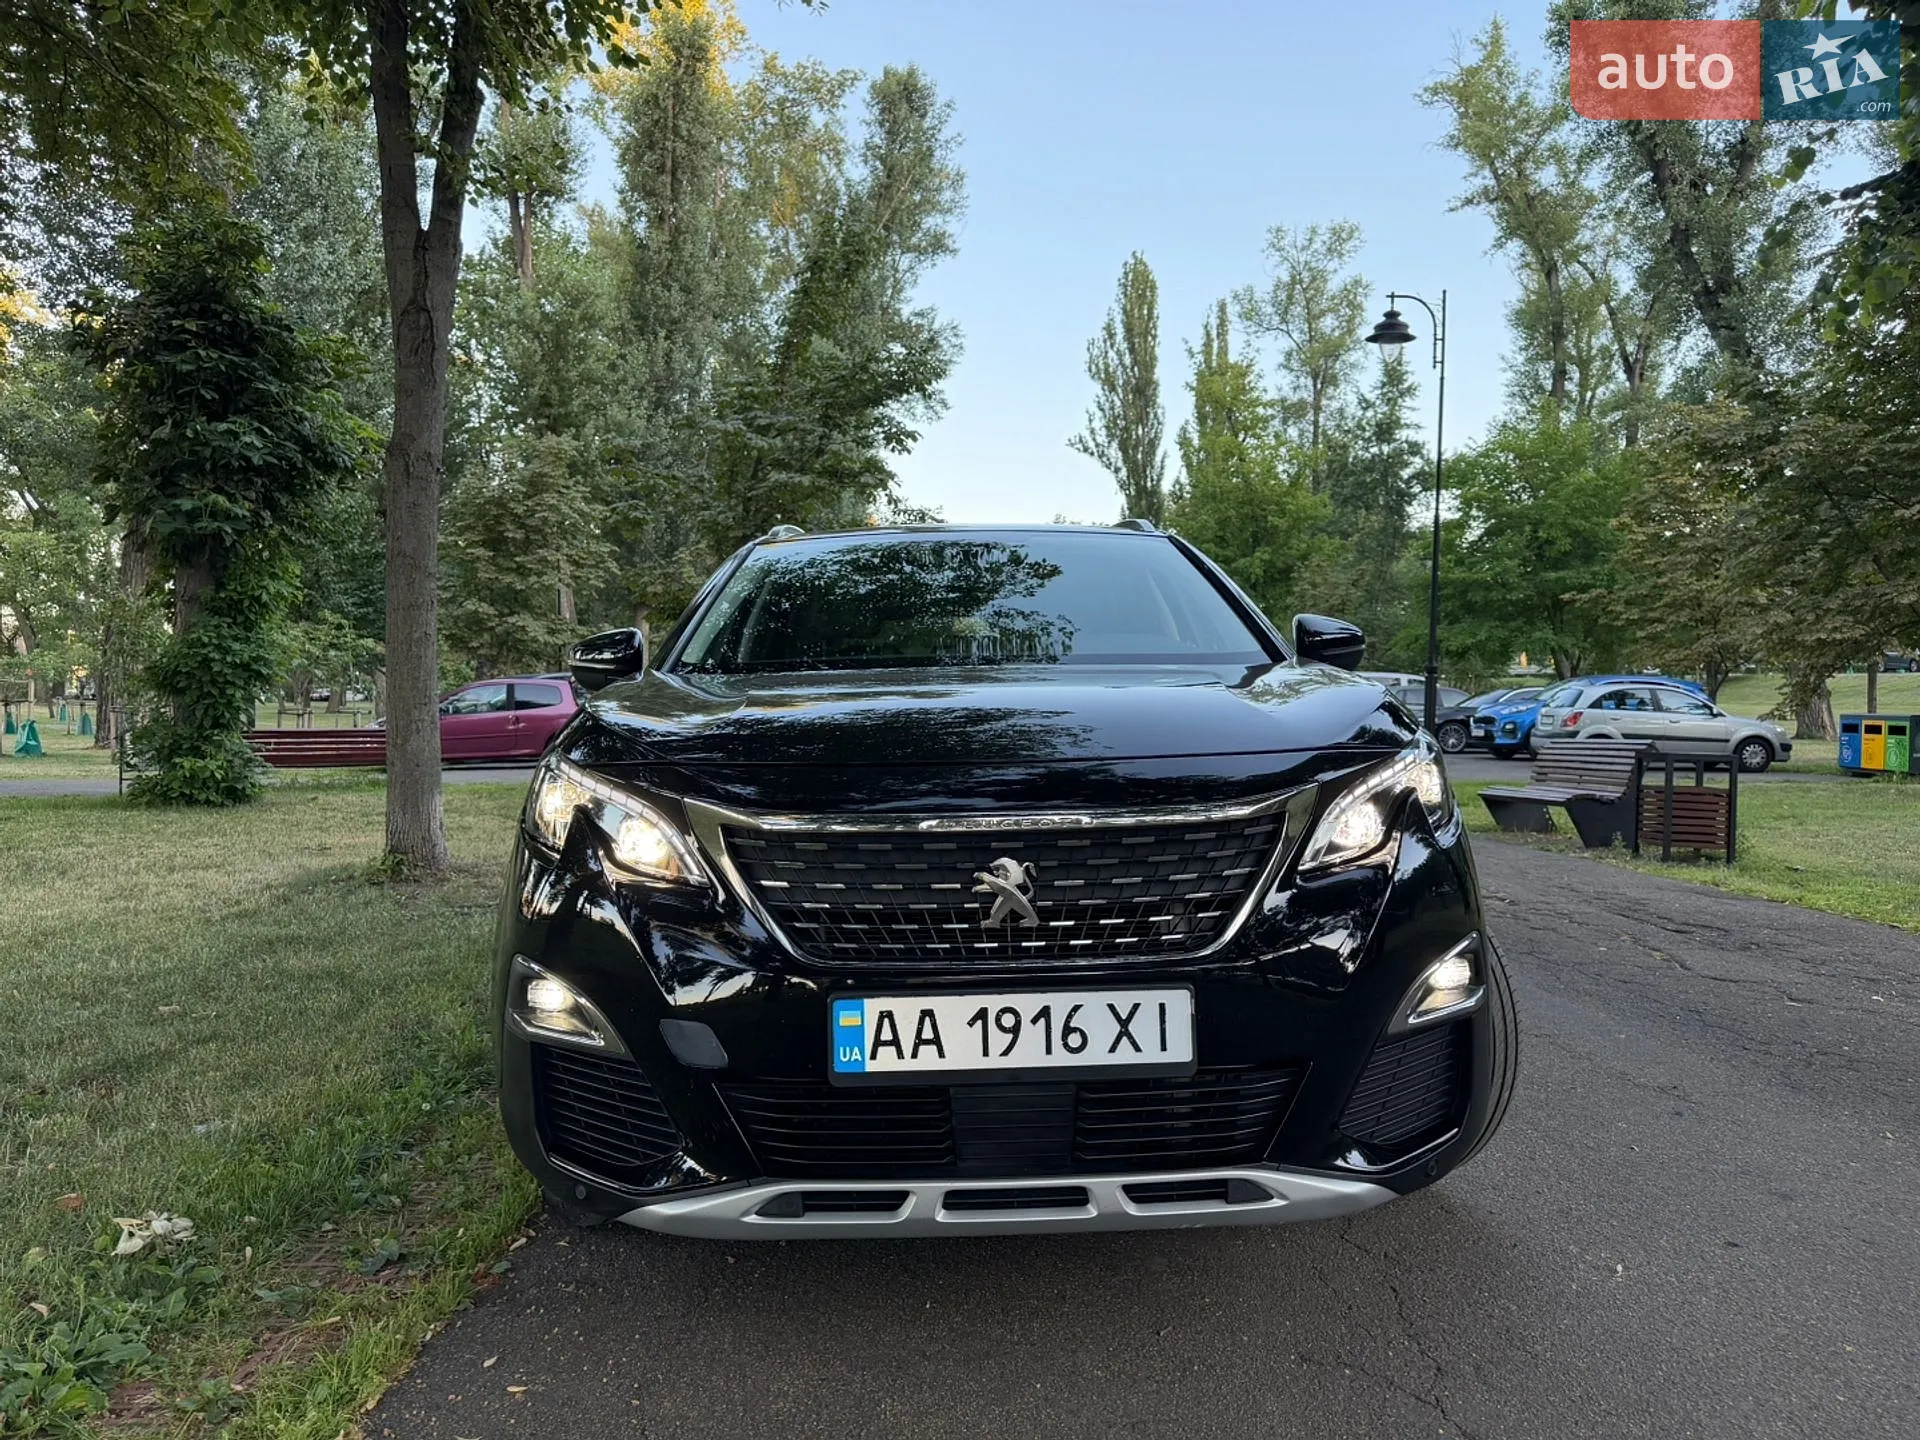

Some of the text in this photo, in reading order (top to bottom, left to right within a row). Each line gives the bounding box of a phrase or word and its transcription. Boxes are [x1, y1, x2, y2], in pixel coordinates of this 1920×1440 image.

[869, 1001, 1169, 1061] AA 1916 XI
[839, 1046, 862, 1062] UA
